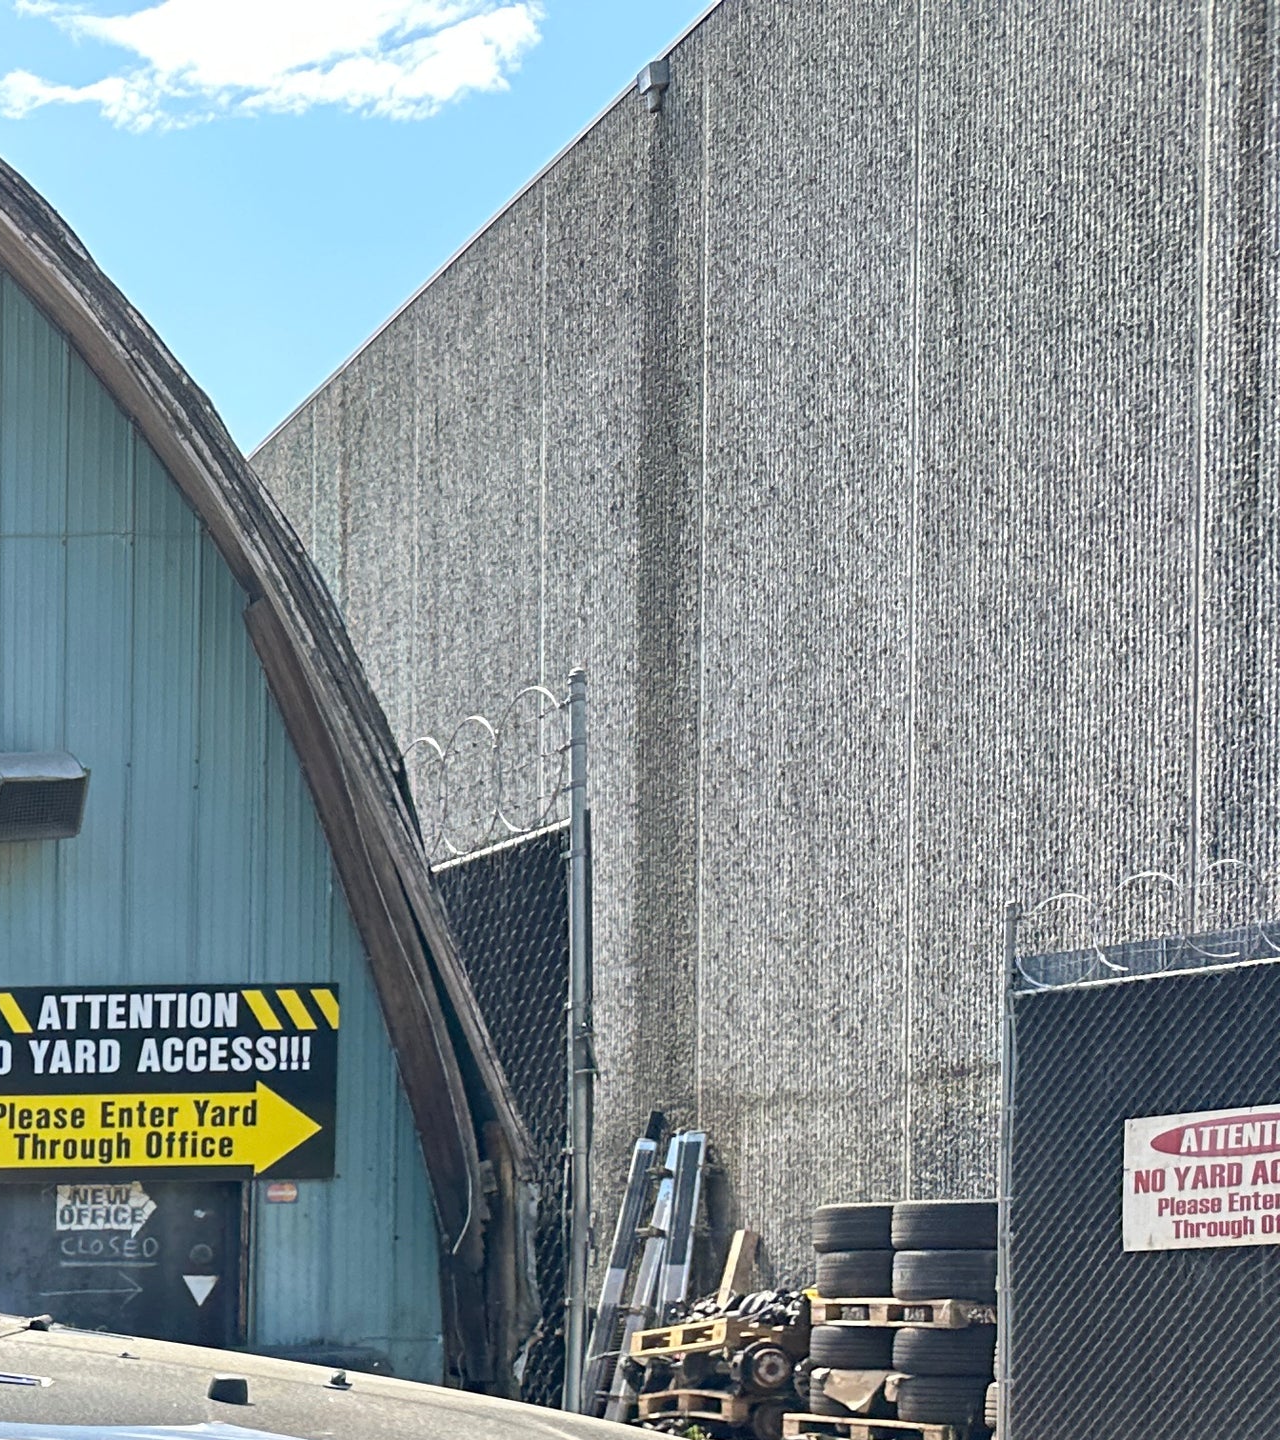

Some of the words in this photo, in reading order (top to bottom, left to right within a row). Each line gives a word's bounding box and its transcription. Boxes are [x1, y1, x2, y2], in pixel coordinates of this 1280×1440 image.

[37, 991, 238, 1031] ATTENTION
[28, 1038, 121, 1075] YARD
[136, 1035, 311, 1073] ACCESS!!!
[100, 1100, 179, 1129] Enter
[193, 1098, 258, 1127] Yard
[13, 1131, 132, 1165] Through
[145, 1130, 234, 1159] Office
[1133, 1168, 1166, 1195] NO
[1173, 1162, 1243, 1192] YARD
[70, 1187, 131, 1206] NEW
[1157, 1196, 1223, 1217] Please
[59, 1204, 146, 1226] OFFICE
[1172, 1215, 1255, 1240] Through
